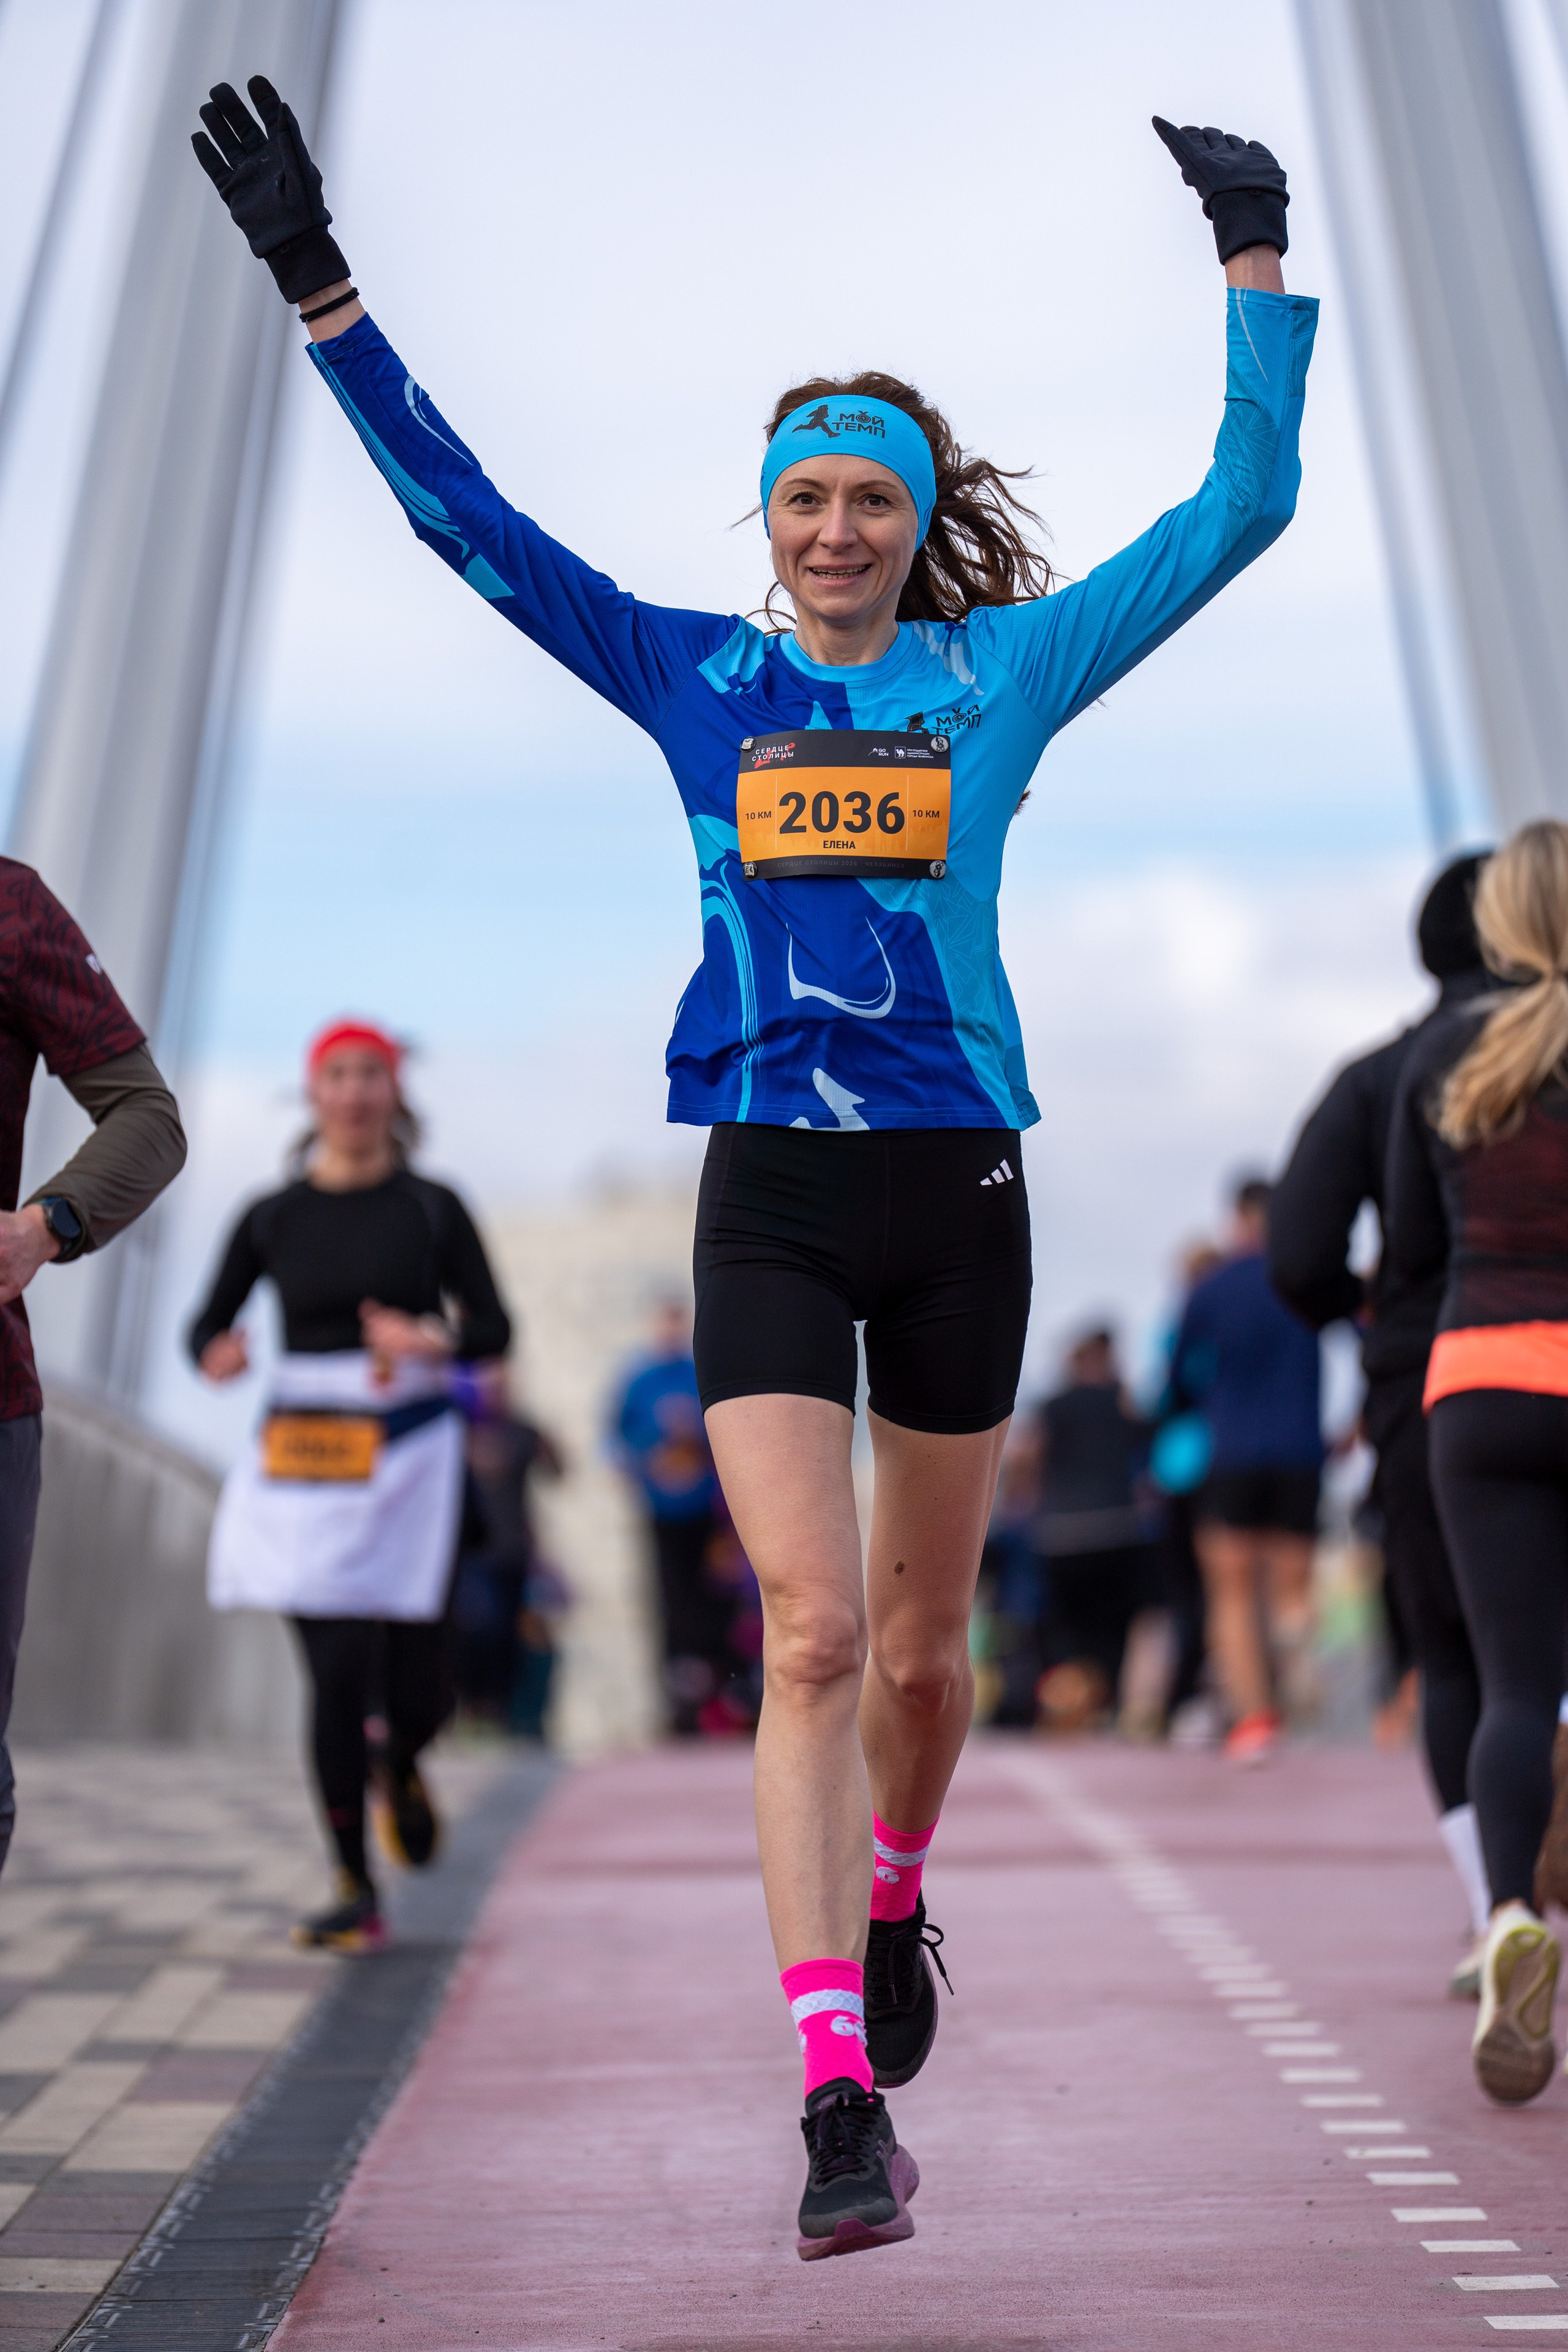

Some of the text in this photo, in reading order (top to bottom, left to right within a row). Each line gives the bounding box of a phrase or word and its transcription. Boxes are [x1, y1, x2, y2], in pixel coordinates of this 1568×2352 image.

[839, 410, 885, 428] МОЙ
[831, 422, 886, 439] ТЕМП
[932, 714, 981, 734] ТЕМП
[755, 745, 789, 755] СЕРДЦЕ
[752, 752, 794, 761] СТОЛИЦЫ
[758, 810, 772, 819] КМ
[778, 790, 905, 834] 2036
[925, 810, 940, 818] КМ
[823, 840, 856, 850] ЕЛЕНА
